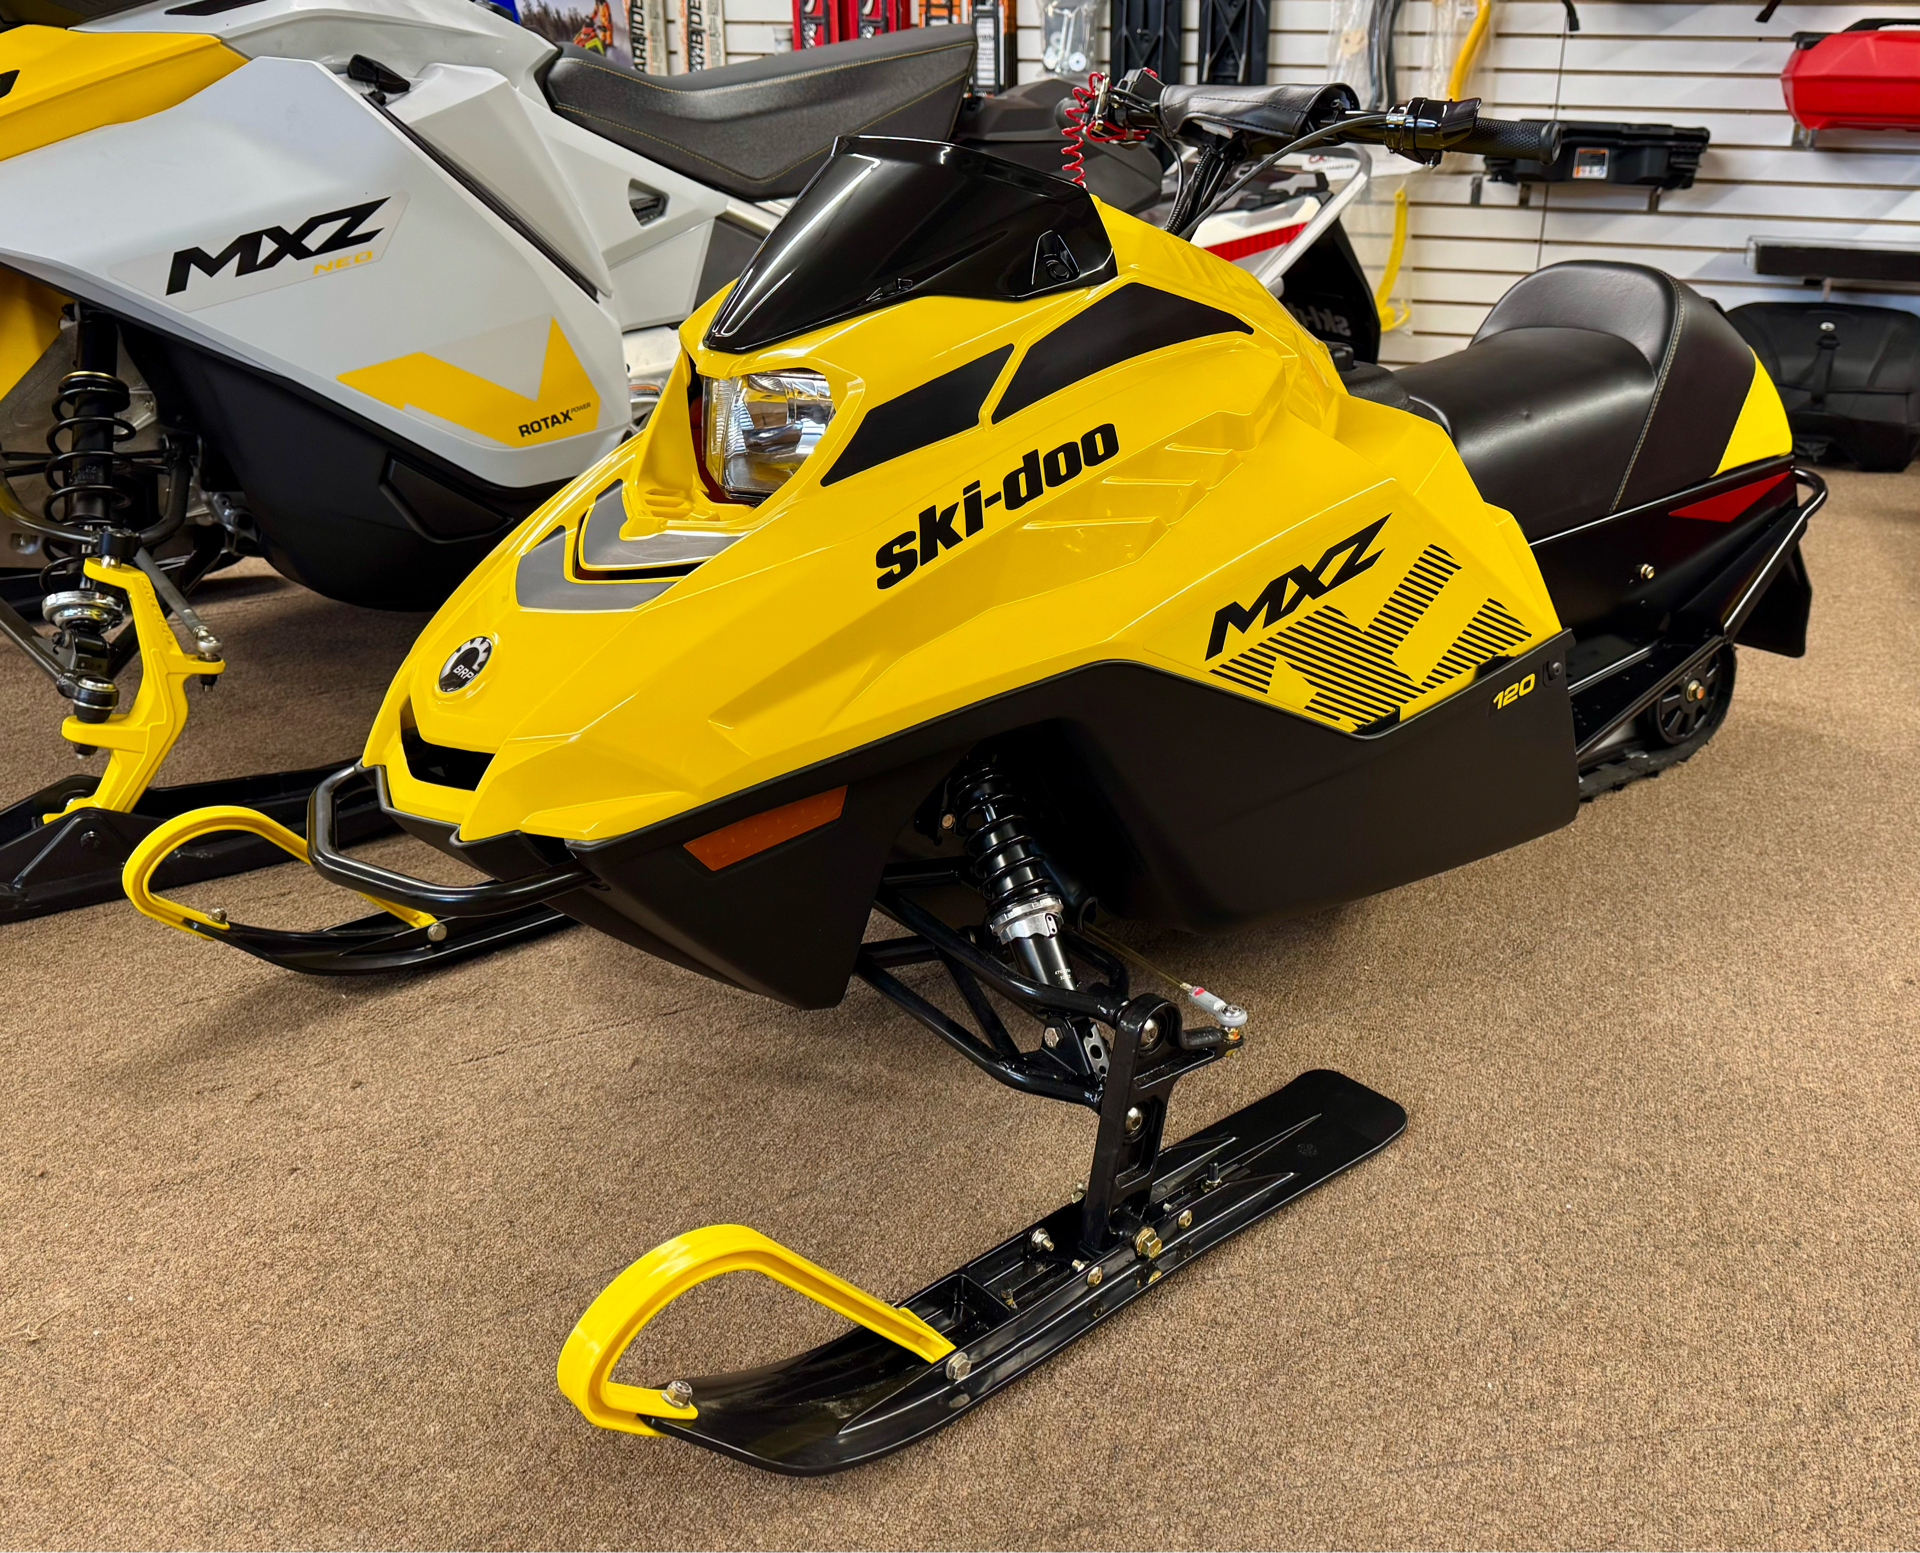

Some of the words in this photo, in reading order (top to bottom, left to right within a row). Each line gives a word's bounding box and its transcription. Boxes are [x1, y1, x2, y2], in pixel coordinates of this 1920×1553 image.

[165, 196, 391, 296] MXZ
[312, 250, 373, 275] NEO
[518, 409, 573, 438] ROTAX
[570, 402, 591, 414] POWER
[875, 423, 1120, 590] ski-doo
[1205, 512, 1393, 661] MXZ
[453, 664, 475, 680] BRP
[1493, 673, 1536, 710] 120
